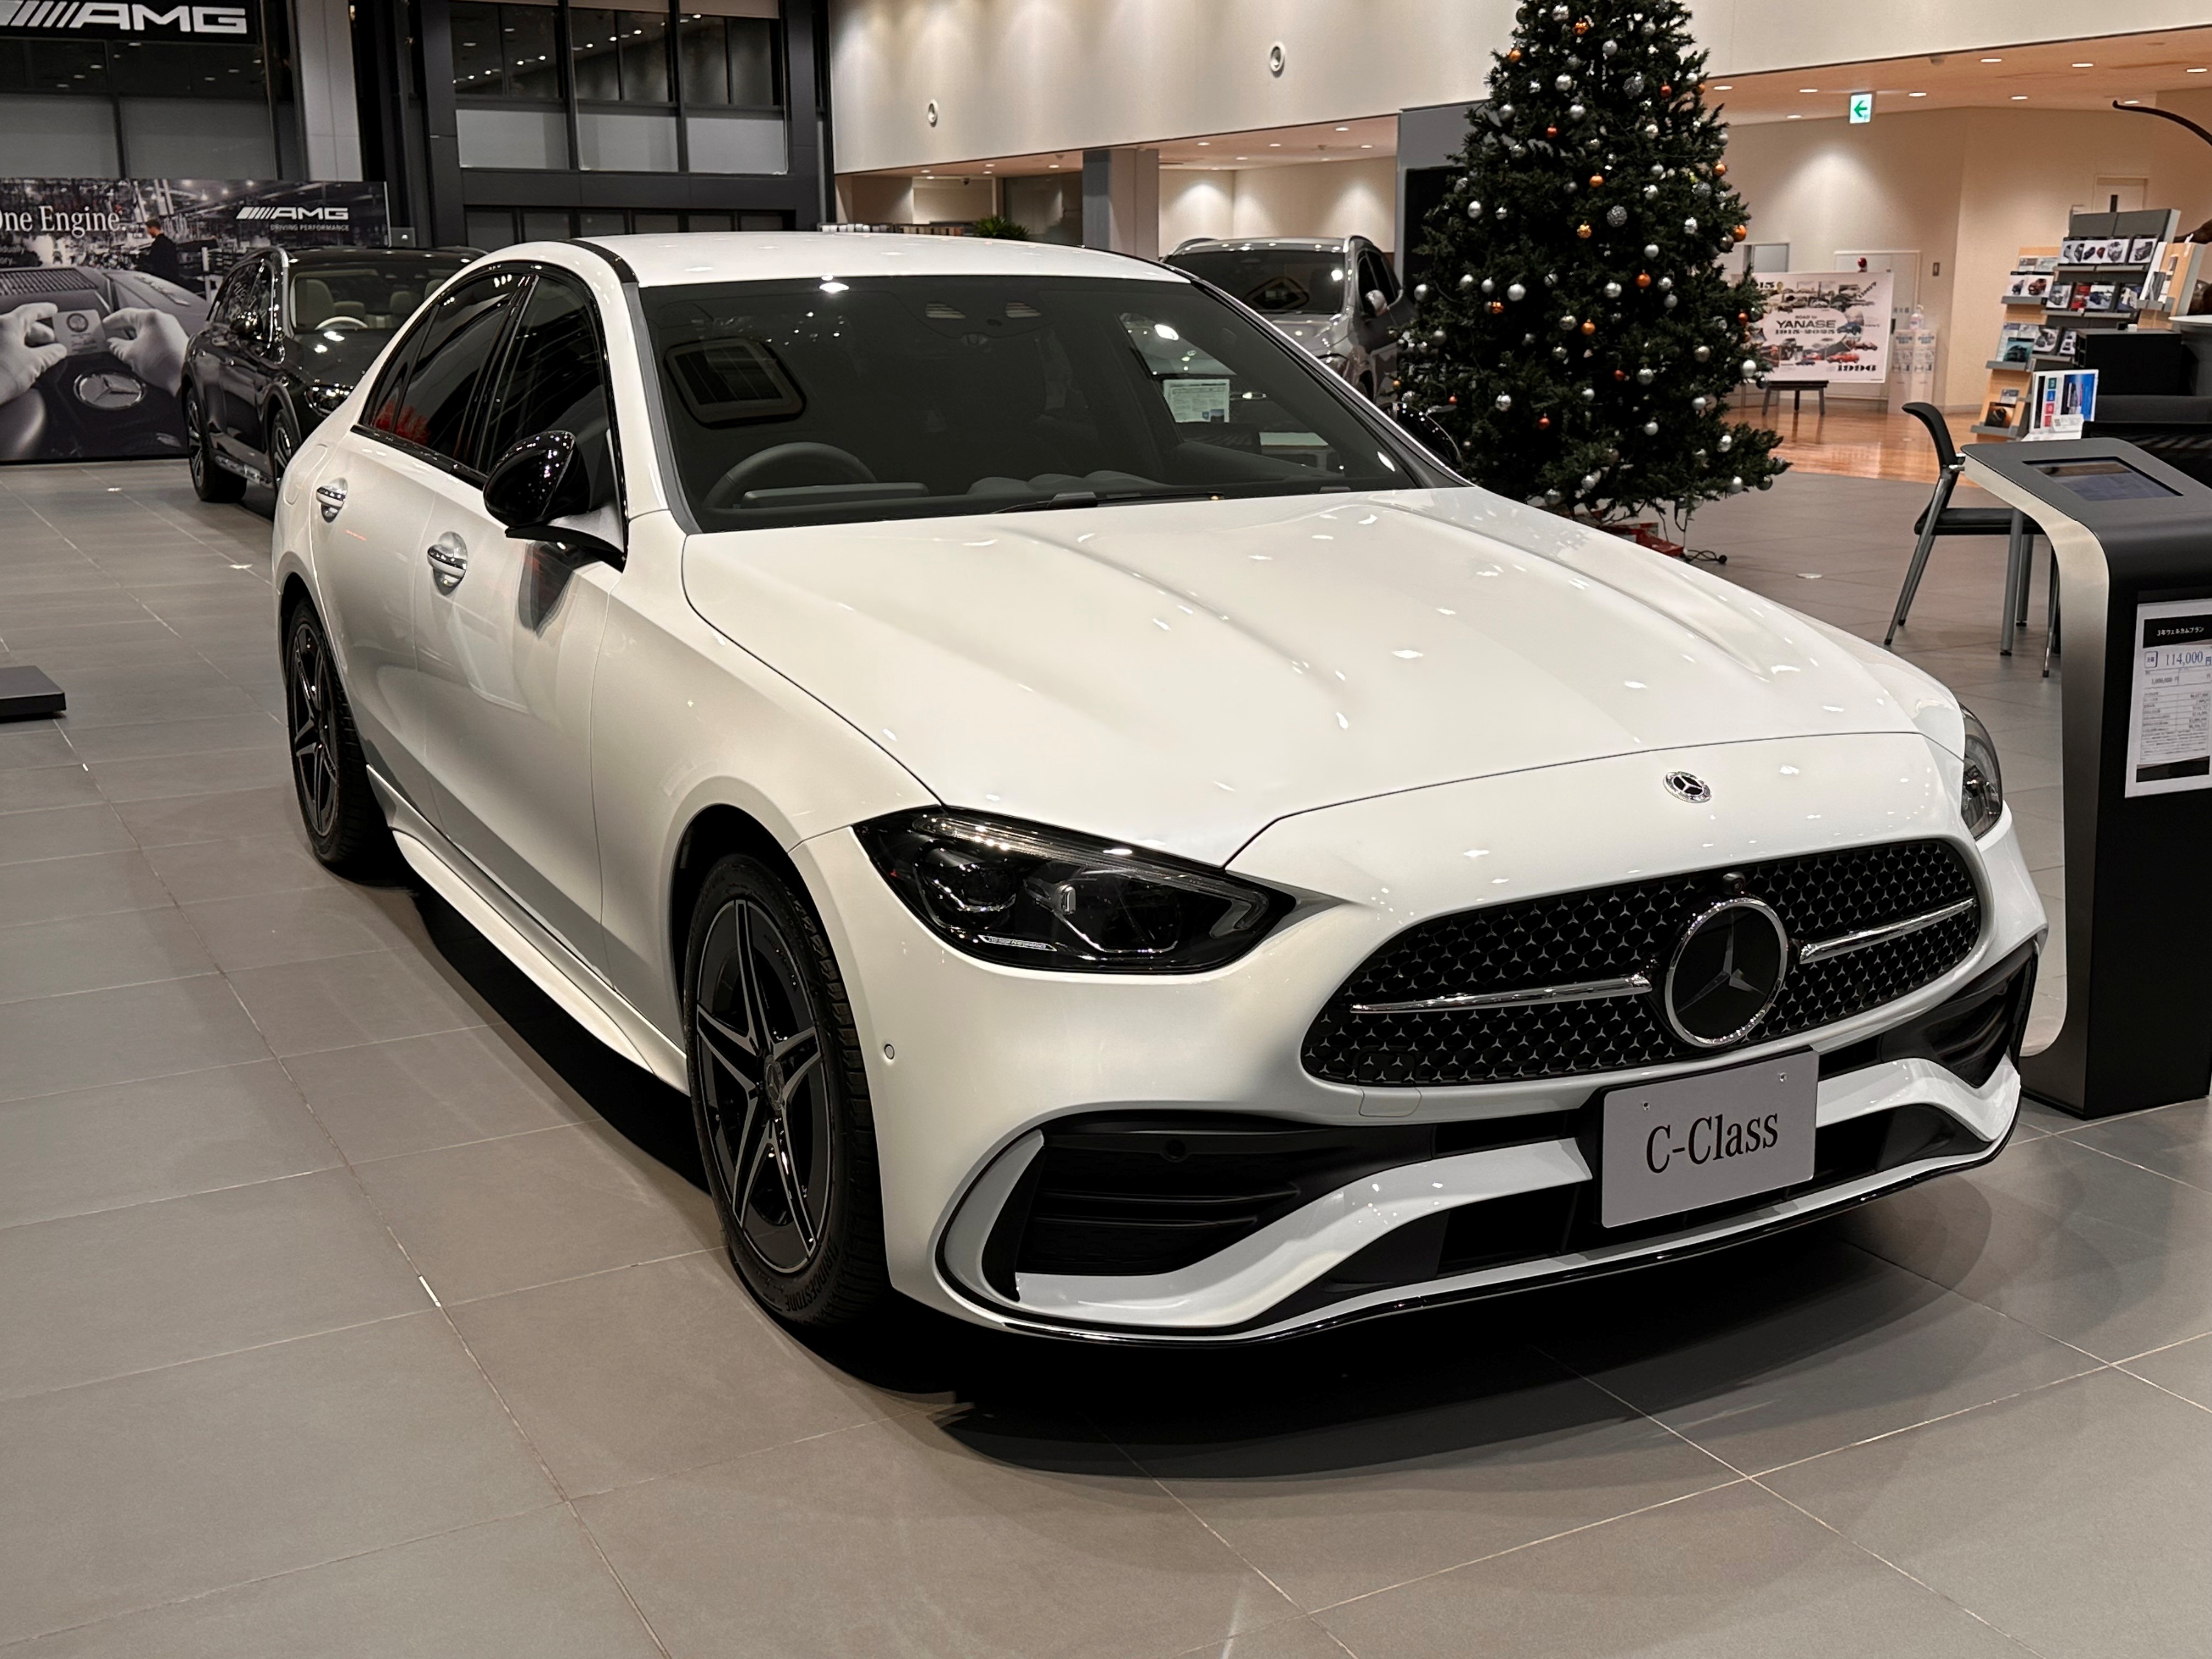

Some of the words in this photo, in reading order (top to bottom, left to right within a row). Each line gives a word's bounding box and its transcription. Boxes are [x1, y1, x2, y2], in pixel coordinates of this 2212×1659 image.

[69, 2, 247, 34] AMG
[0, 209, 33, 232] ne
[38, 205, 126, 238] Engine.
[269, 206, 349, 220] AMG
[1776, 320, 1837, 329] YANASE
[2166, 651, 2203, 666] 114,000
[1646, 1113, 1778, 1173] C-Class
